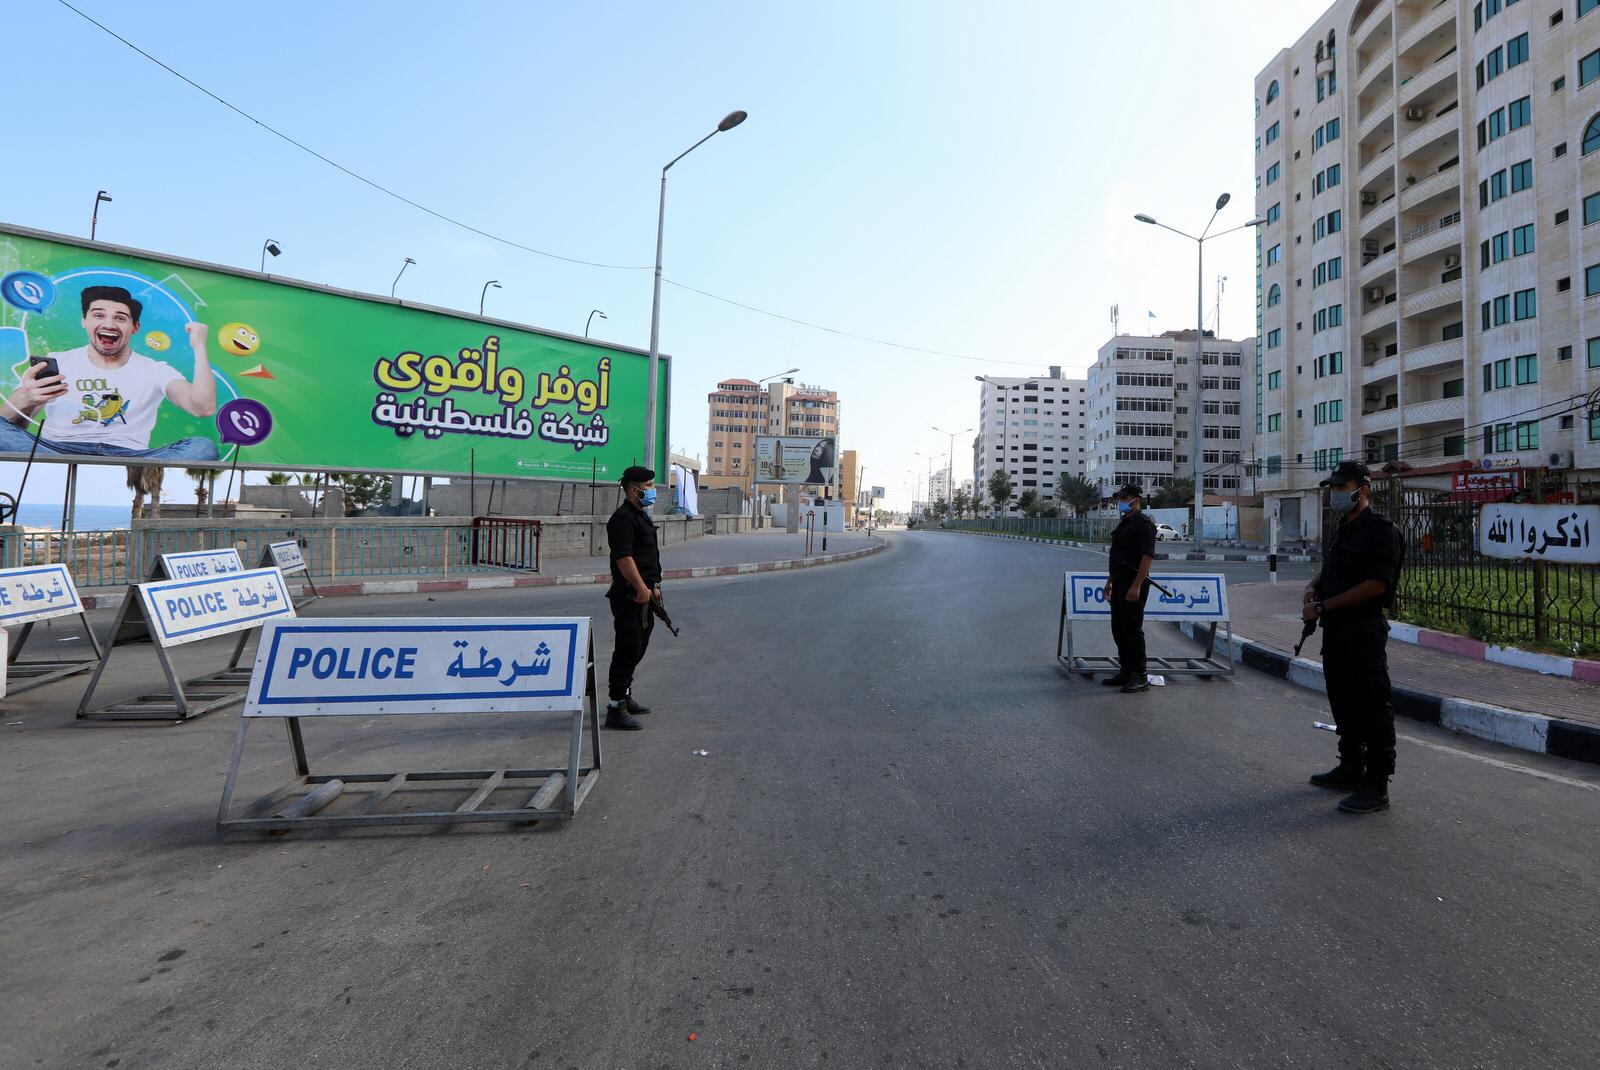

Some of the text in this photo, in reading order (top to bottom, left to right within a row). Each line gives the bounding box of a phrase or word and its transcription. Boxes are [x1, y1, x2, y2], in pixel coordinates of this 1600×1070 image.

[76, 379, 112, 391] COOL
[374, 336, 610, 413] أوفر وأقوى
[373, 393, 609, 450] شبكة فلسطينية
[1487, 507, 1590, 555] اذكروا الله
[176, 562, 209, 579] POLICE
[15, 577, 64, 604] شرطة
[232, 581, 279, 609] شرطة
[1159, 585, 1210, 609] شرطة
[165, 591, 228, 621] POLICE
[287, 647, 418, 680] POLICE
[446, 640, 551, 687] شرطة
